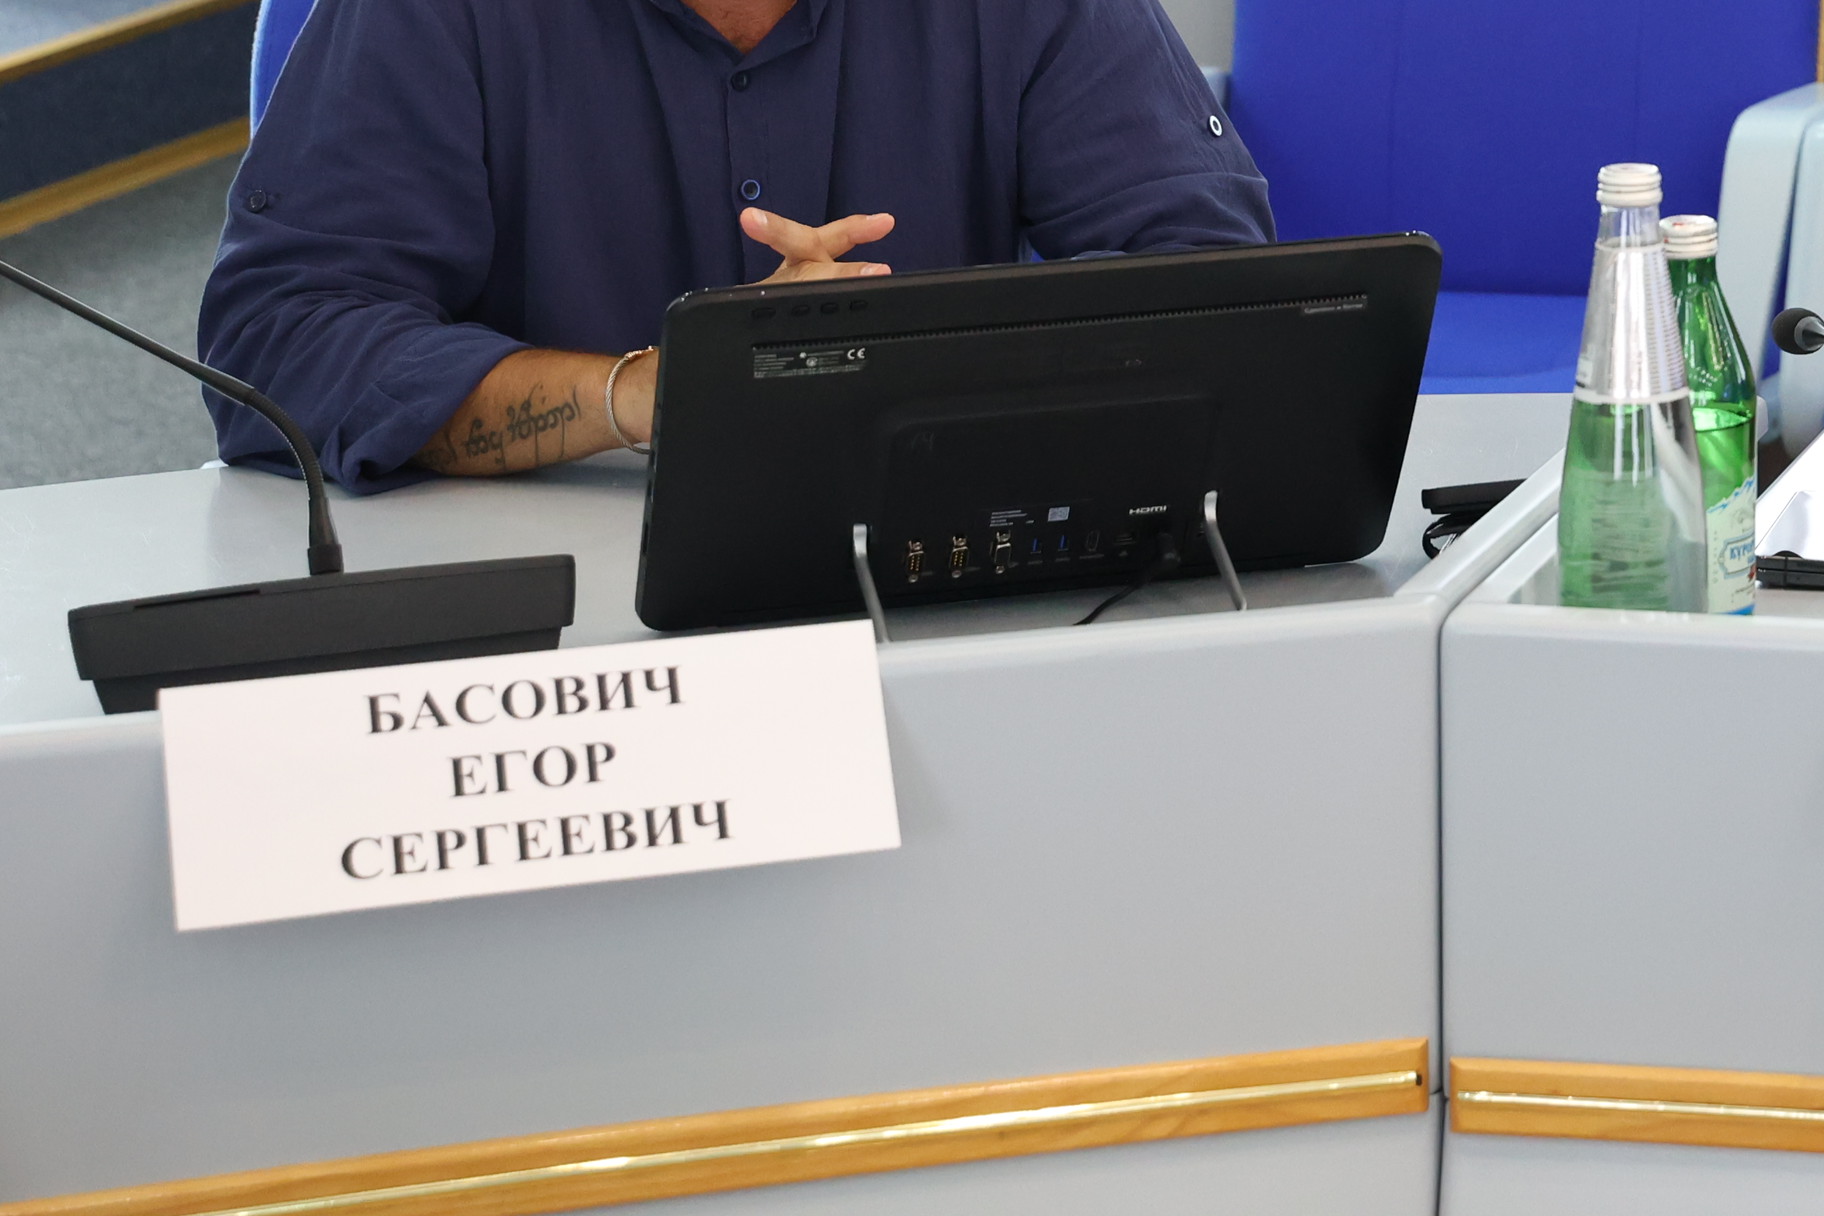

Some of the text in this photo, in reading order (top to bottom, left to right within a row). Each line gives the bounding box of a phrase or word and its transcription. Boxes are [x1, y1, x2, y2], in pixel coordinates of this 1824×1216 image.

[364, 664, 686, 735] БАСОВИЧ
[449, 741, 618, 798] ЕГОР
[339, 798, 735, 881] СЕРГЕЕВИЧ
